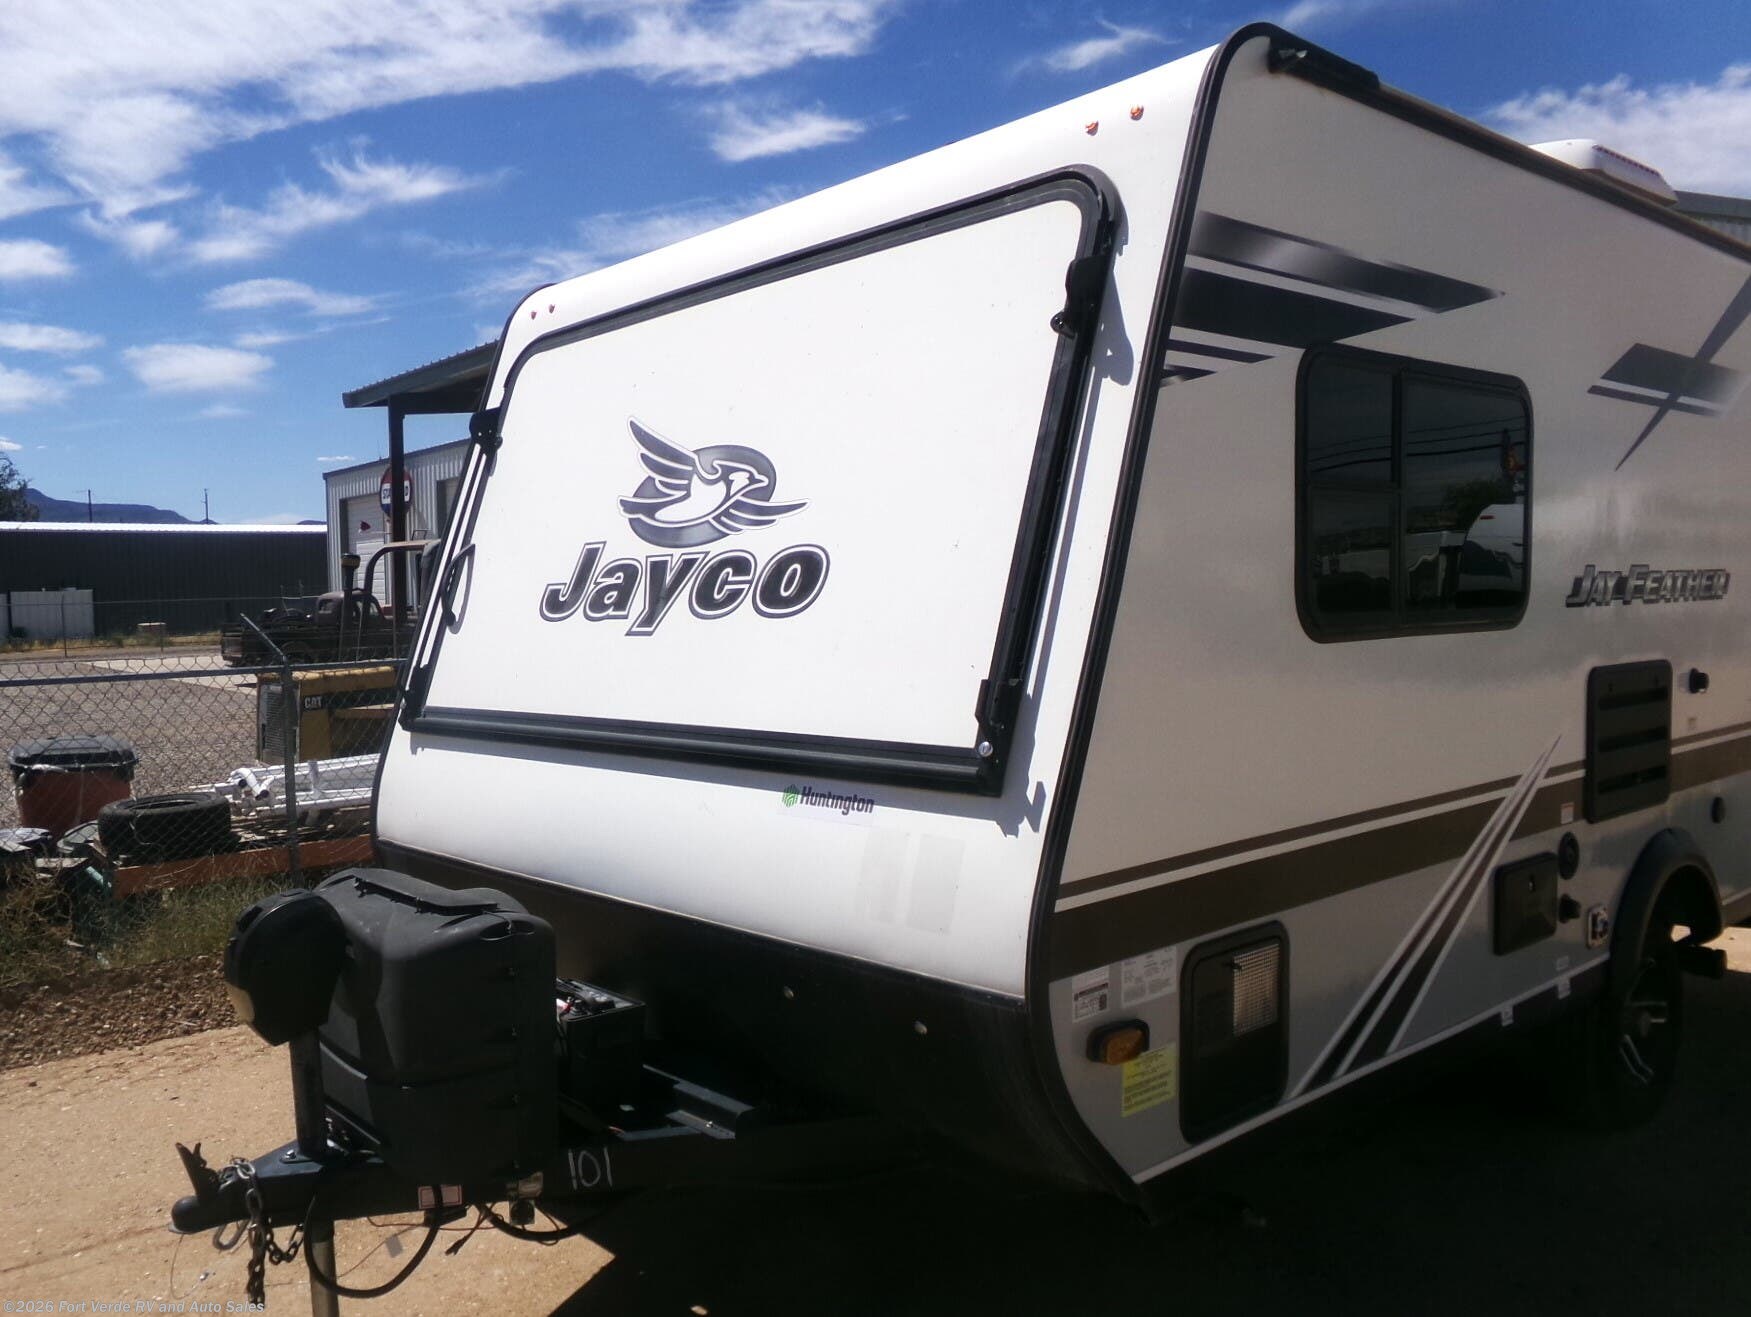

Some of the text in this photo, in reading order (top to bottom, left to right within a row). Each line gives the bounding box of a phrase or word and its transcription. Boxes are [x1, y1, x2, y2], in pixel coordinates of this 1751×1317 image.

[540, 541, 830, 636] Jayco
[1566, 564, 1731, 607] JAY FEATHER
[304, 696, 322, 709] CAT
[800, 786, 875, 816] Huntington
[567, 1147, 613, 1191] 101
